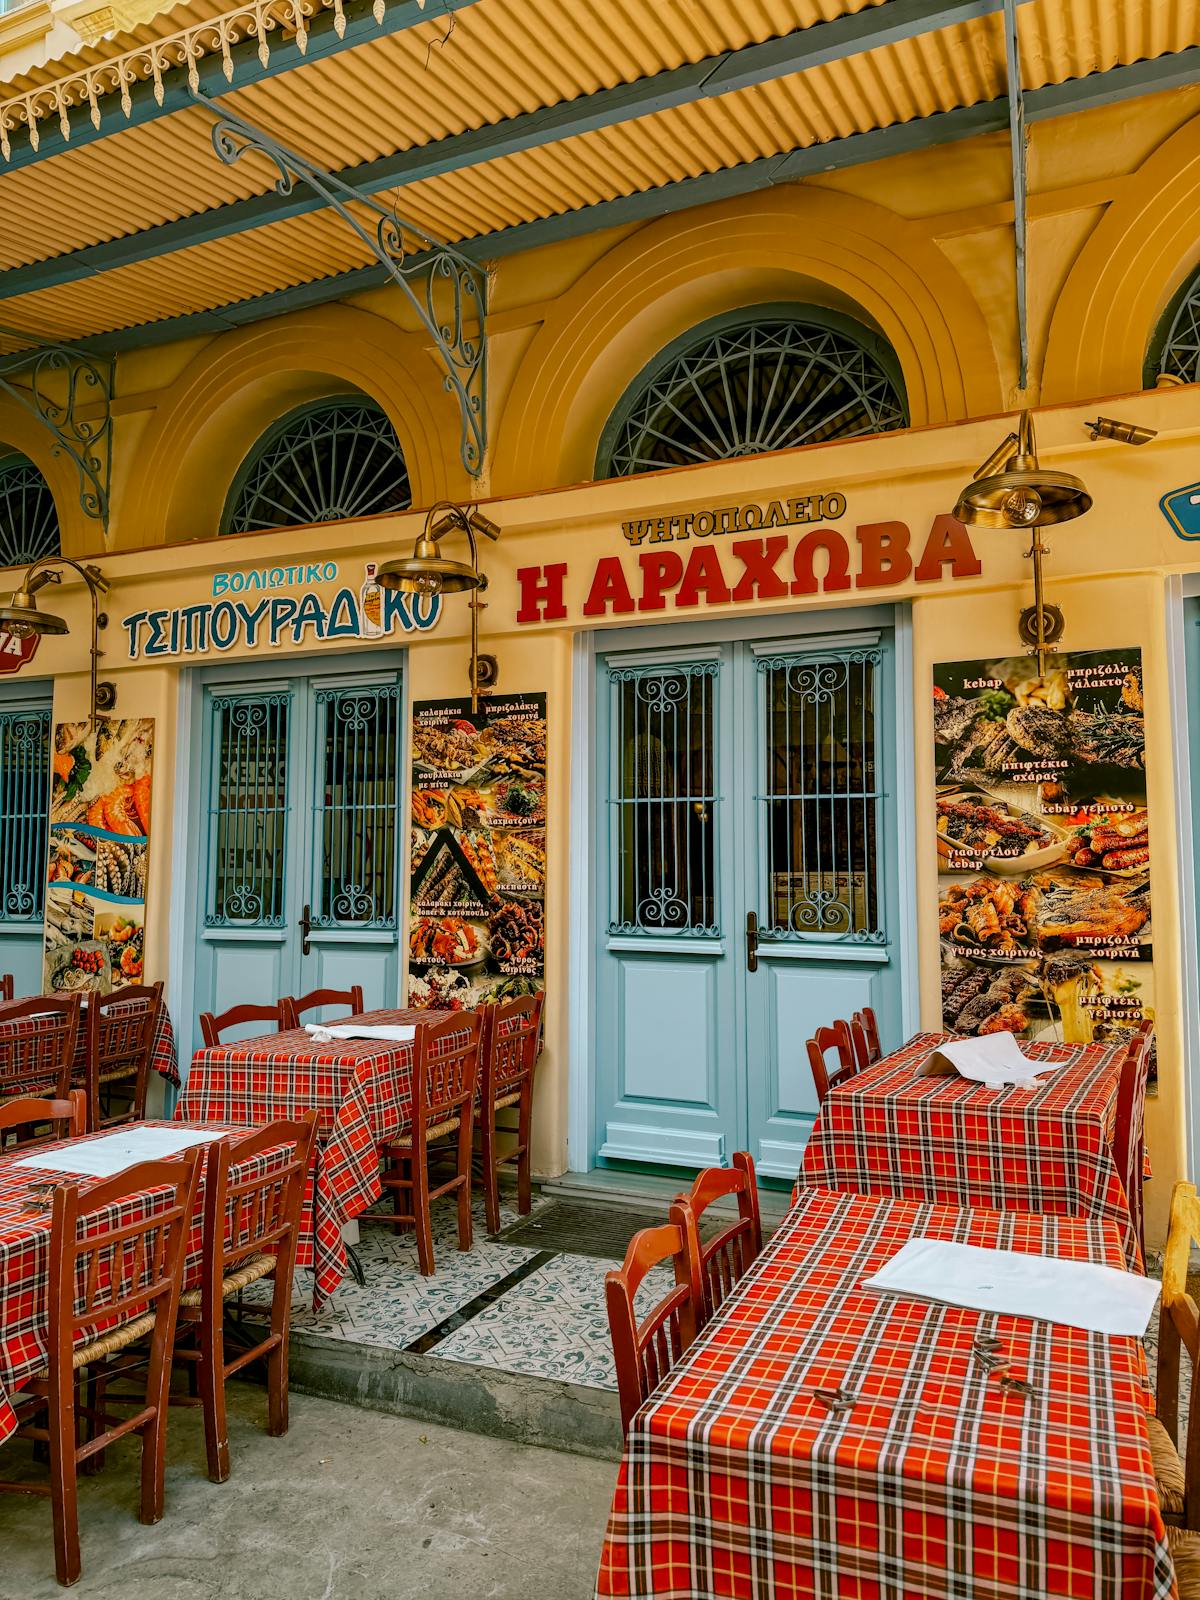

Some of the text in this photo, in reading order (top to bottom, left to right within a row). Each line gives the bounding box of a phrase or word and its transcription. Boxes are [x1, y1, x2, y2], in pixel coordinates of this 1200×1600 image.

[621, 492, 847, 546] ΨΗΤΟΠΩΛΕΙΟ
[516, 513, 982, 623] Η ΑΡΑΧΩΒΑ
[212, 561, 337, 597] ΒΟΛΙΩΤΙΚΟ
[1067, 664, 1130, 679] μπριζόλα
[963, 678, 1003, 690] kebap
[1067, 676, 1130, 691] γάλακτος
[419, 707, 462, 718] καλαμάκια
[485, 702, 539, 715] μπριζολάκια
[1001, 758, 1069, 772] μπιφτέκια
[1012, 771, 1058, 783] σχάρας
[418, 780, 449, 790] με πίτα
[1040, 803, 1135, 816] kebap γεμιστό
[947, 847, 1020, 859] γιαουρτλού
[948, 859, 984, 871] kebap
[1075, 935, 1140, 947] μπριζόλα
[951, 946, 1044, 960] γύρος χοιρινός
[1089, 947, 1141, 959] χοιρινή
[1078, 994, 1141, 1007] μπιφτέκι
[1087, 1007, 1141, 1020] γεμιστό
